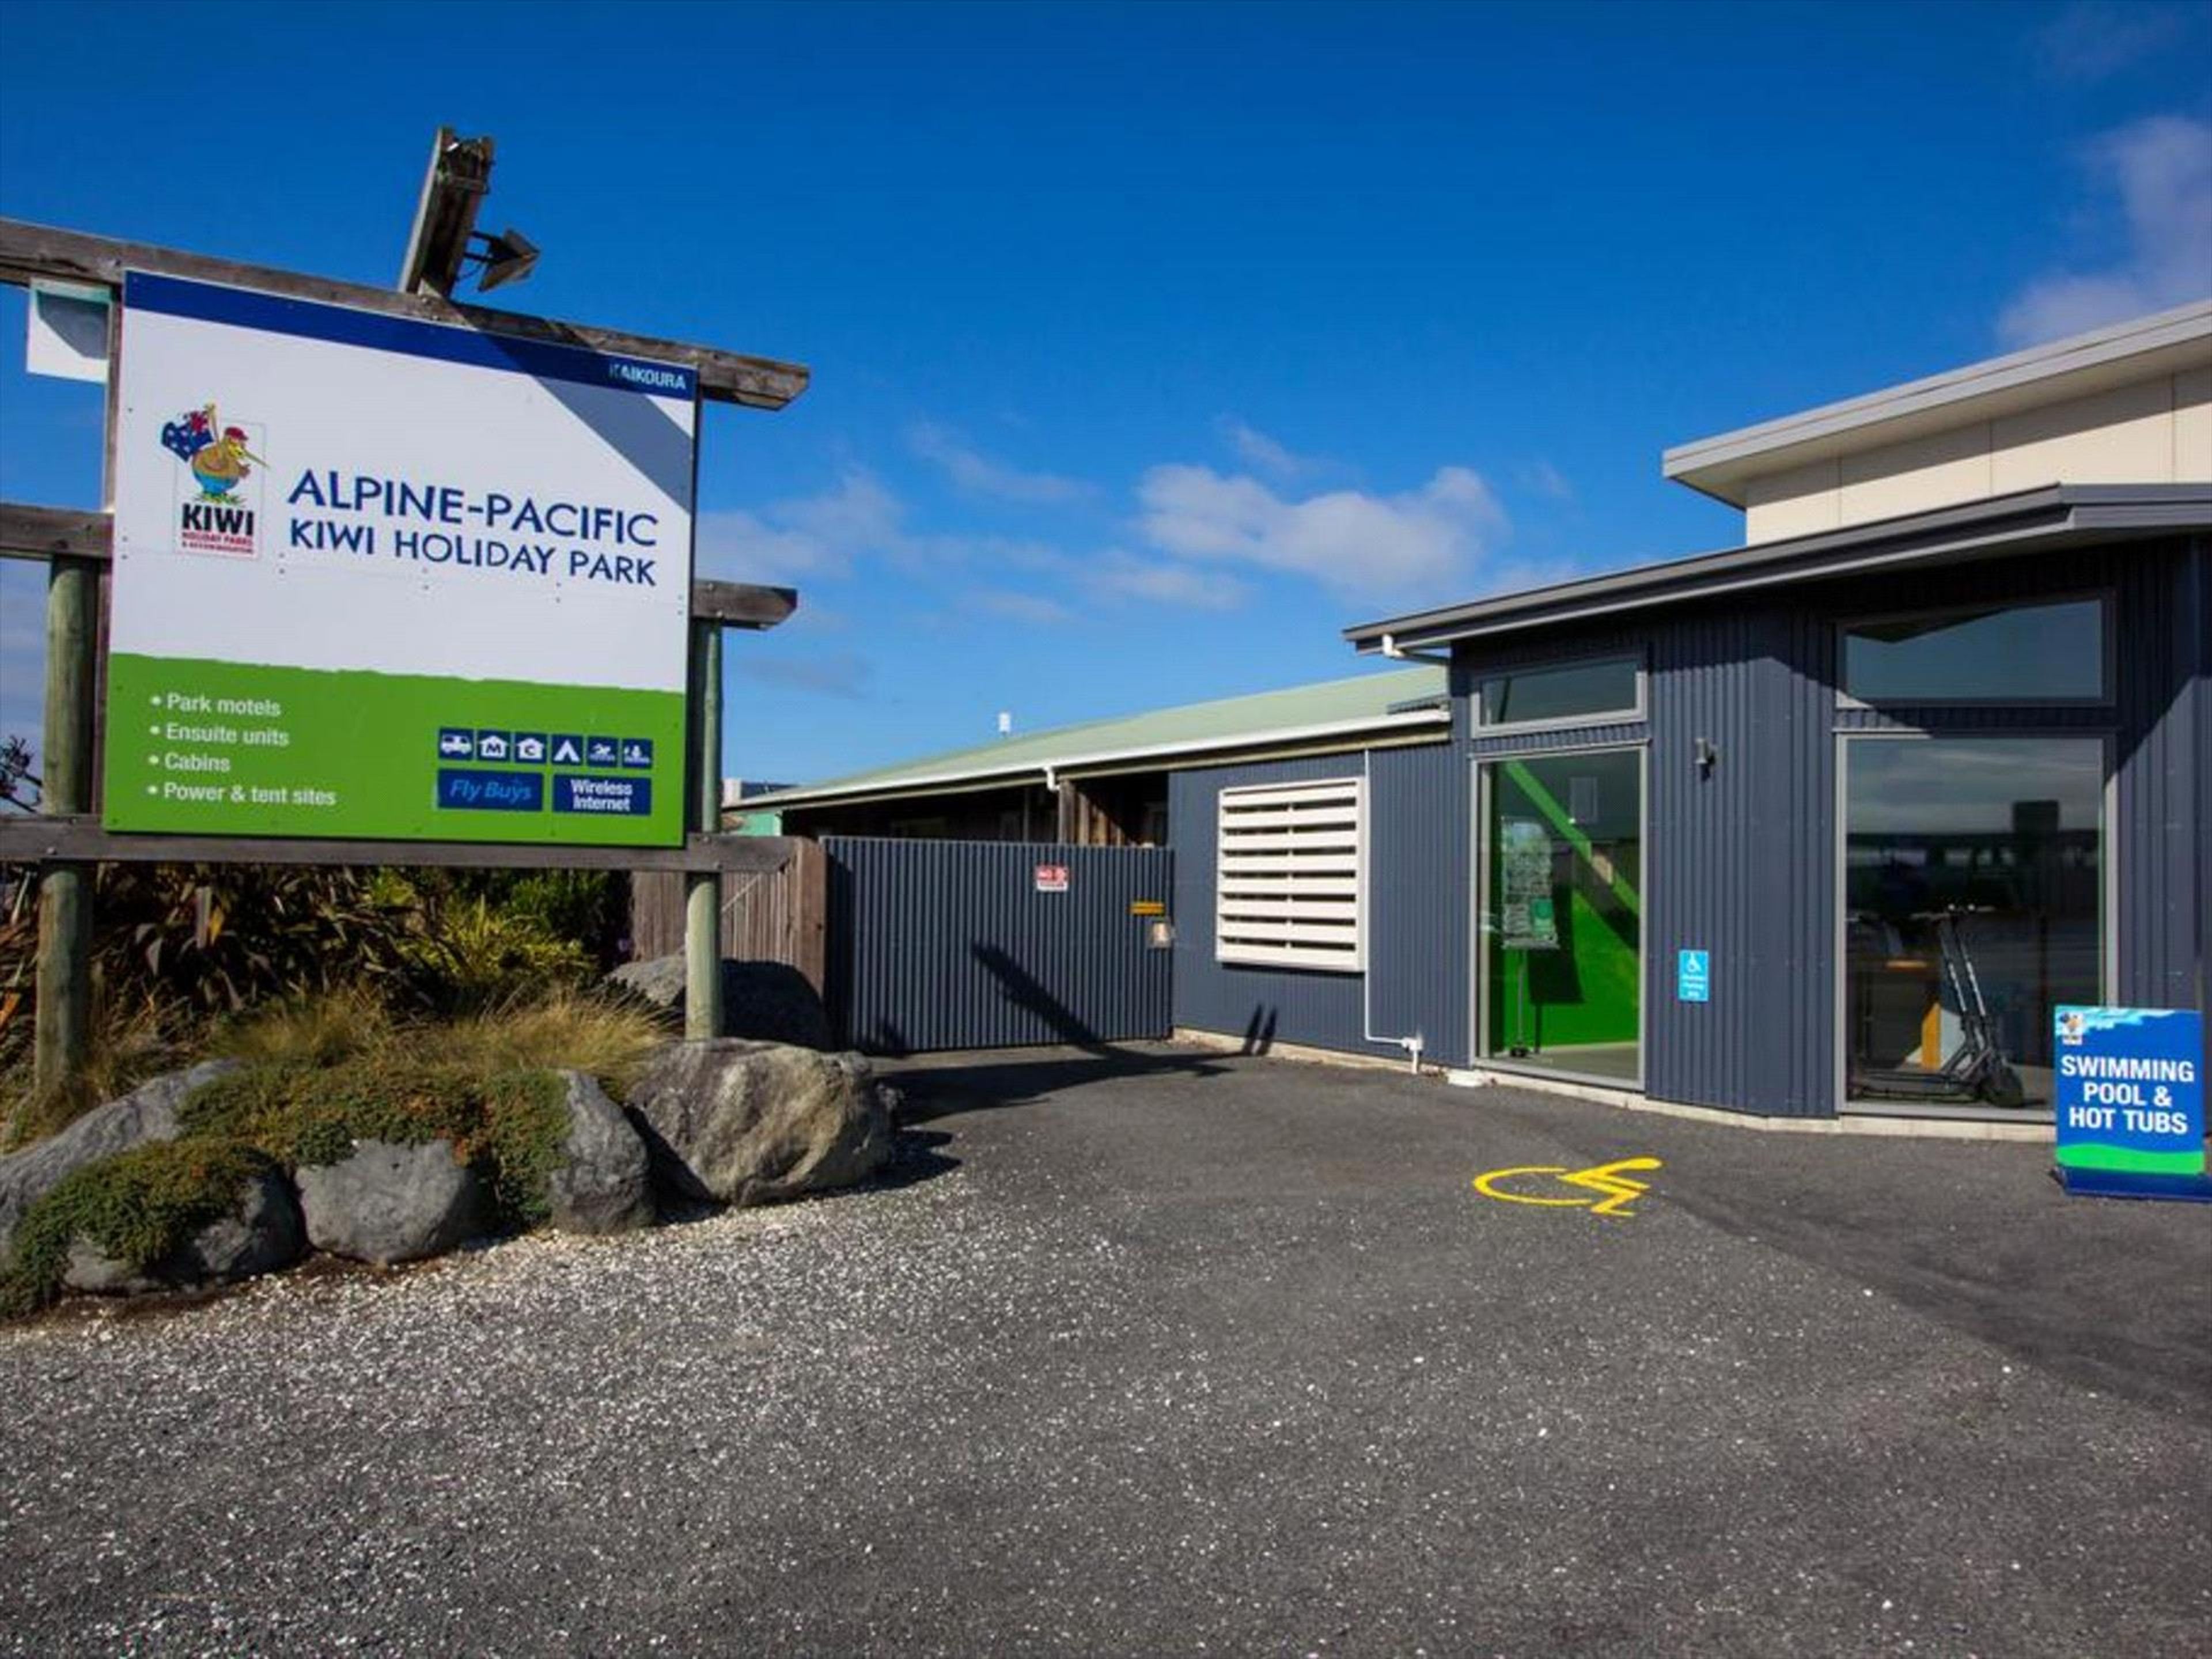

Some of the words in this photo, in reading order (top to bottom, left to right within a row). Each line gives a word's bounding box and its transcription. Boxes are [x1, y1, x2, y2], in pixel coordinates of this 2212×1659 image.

[182, 503, 254, 536] KIWI
[287, 468, 658, 546] ALPINE-PACIFIC
[291, 518, 374, 555] KIWI
[395, 529, 556, 575] HOLIDAY
[570, 550, 656, 586] PARK
[166, 692, 211, 713] Park
[217, 698, 281, 717] motels
[166, 723, 237, 744] Ensuite
[243, 728, 290, 747] units
[164, 752, 232, 772] Cabins
[164, 782, 225, 800] Power
[230, 785, 245, 802] &
[251, 787, 287, 804] tent
[292, 787, 336, 805] sites
[450, 779, 482, 801] Fly
[485, 780, 532, 801] Buys
[571, 778, 632, 796] Wireless
[573, 796, 631, 812] Internet
[2061, 1054, 2195, 1082] SWIMMING
[2084, 1082, 2147, 1107] POOL
[2153, 1085, 2173, 1108] &
[2069, 1107, 2117, 1130] HOT
[2122, 1109, 2188, 1135] TUBS
